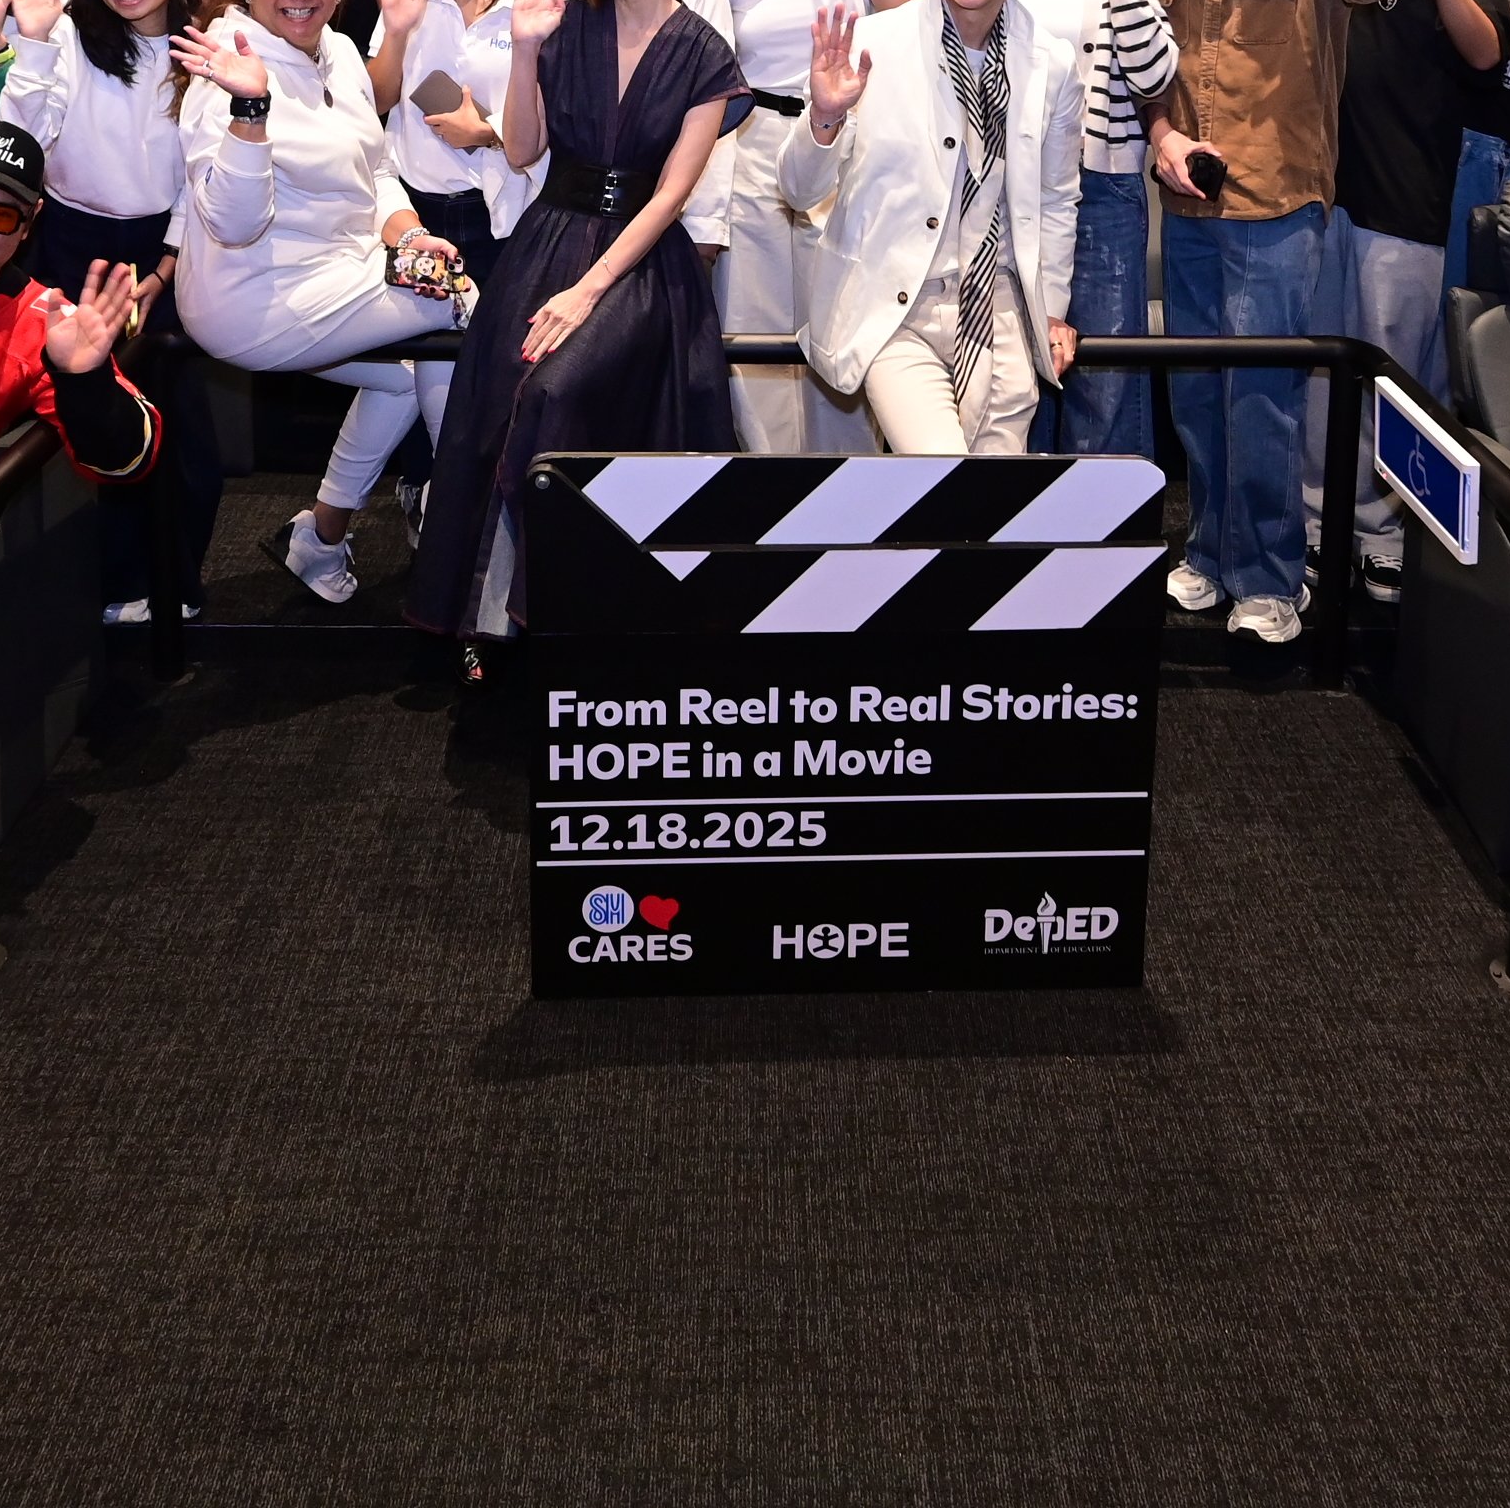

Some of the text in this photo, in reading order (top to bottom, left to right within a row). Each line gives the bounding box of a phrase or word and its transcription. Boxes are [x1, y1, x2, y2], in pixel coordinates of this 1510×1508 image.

[548, 682, 1139, 728] From Reel to Real Stories:
[549, 738, 932, 781] HOPE in a Movie
[550, 810, 827, 851] 12.18.2025
[773, 921, 910, 960] HOPE
[984, 899, 1120, 947] DepED
[568, 933, 693, 964] CARES
[984, 946, 1038, 955] DEPARTMENT
[1063, 945, 1112, 954] EDUCATION
